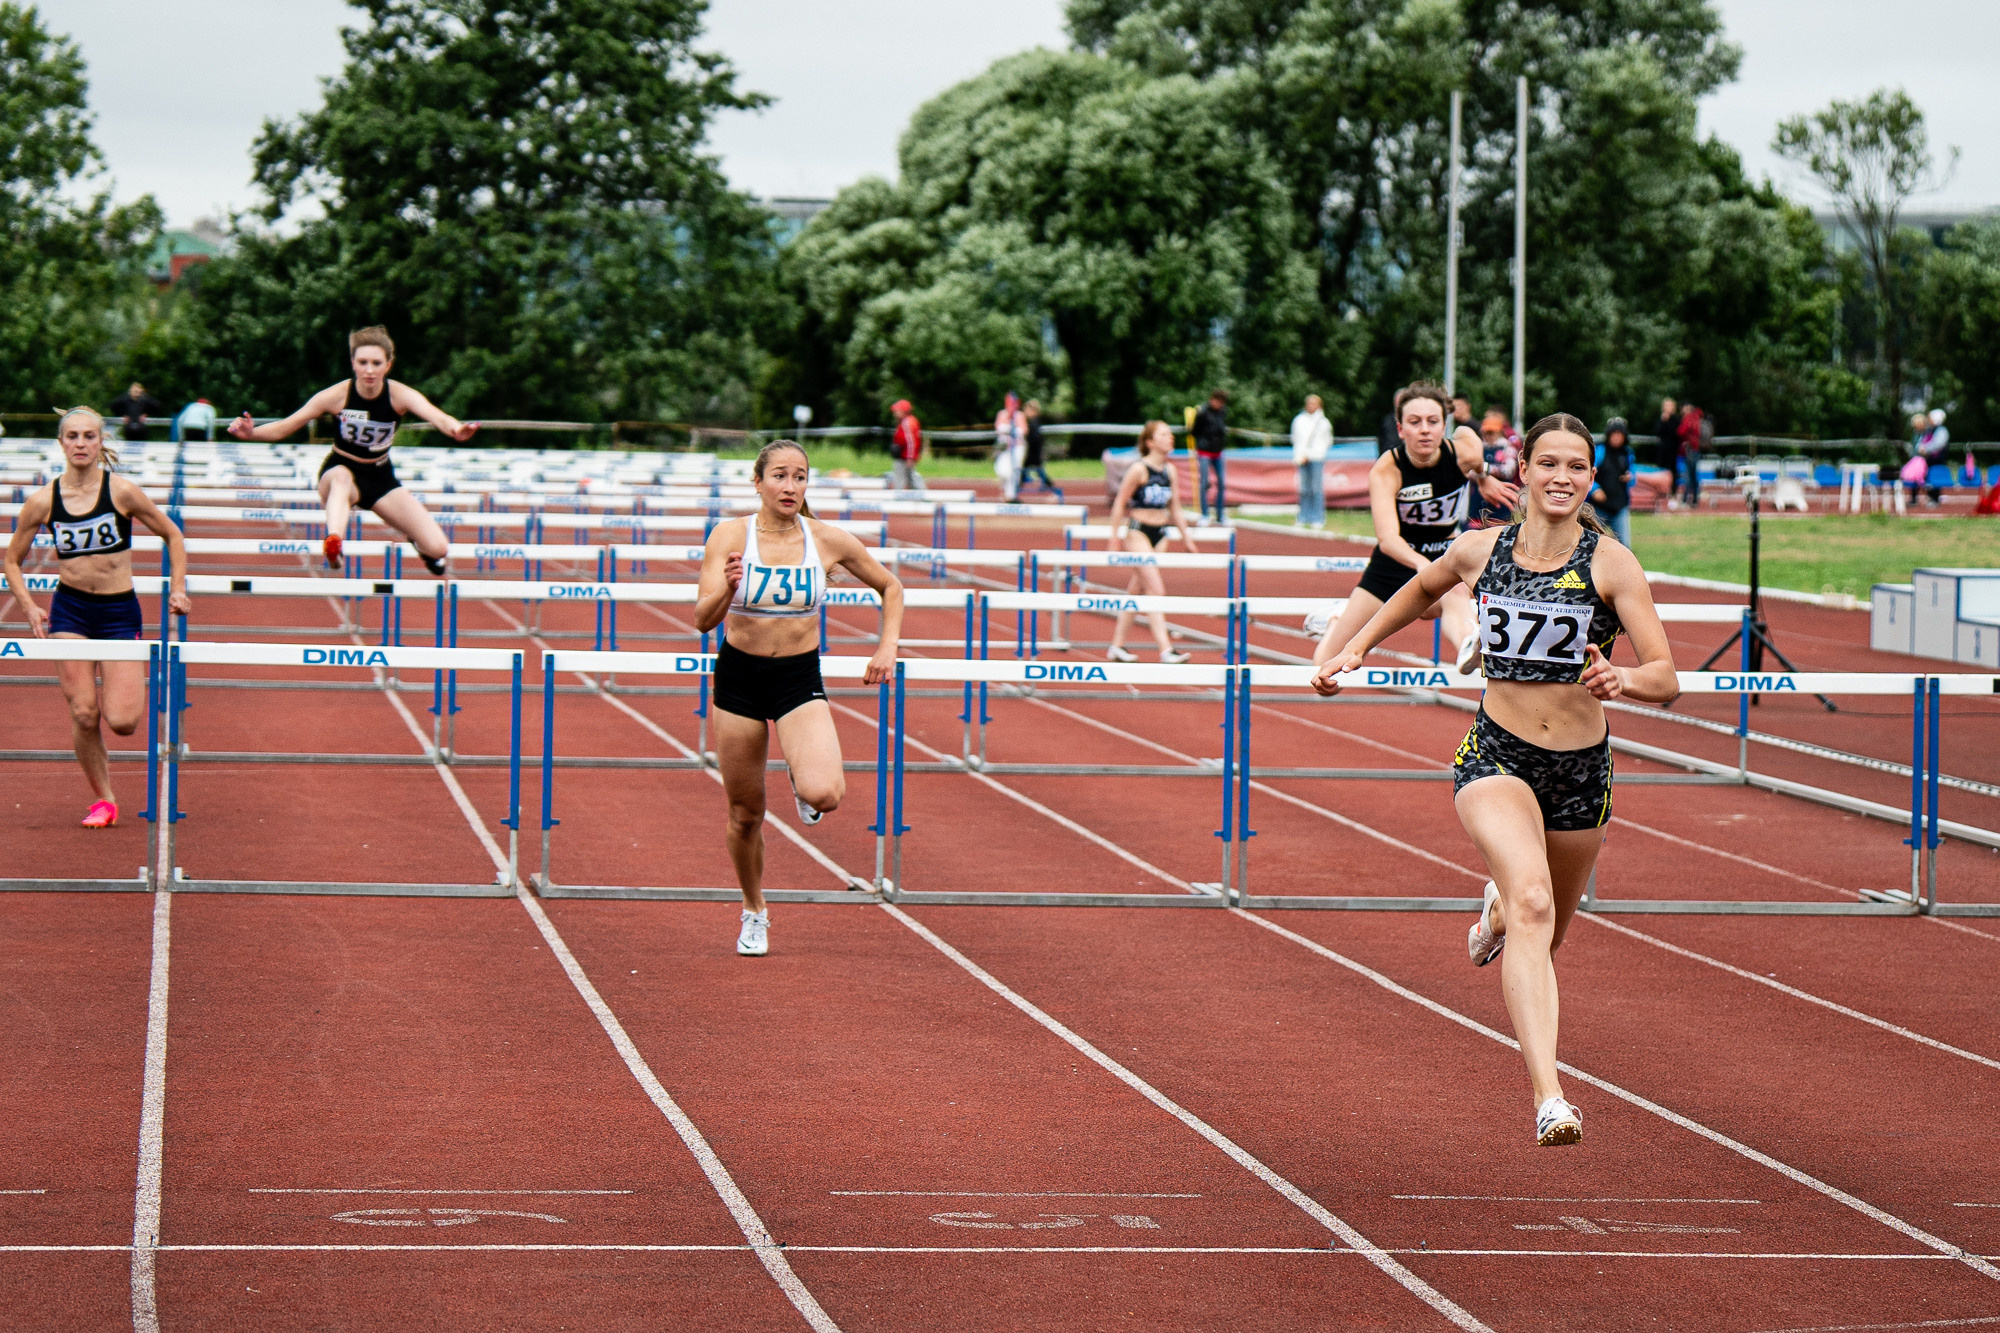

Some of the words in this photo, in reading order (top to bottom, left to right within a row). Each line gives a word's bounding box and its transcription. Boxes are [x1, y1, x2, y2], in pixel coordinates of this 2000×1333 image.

[346, 423, 391, 444] 357
[1397, 488, 1430, 498] NIKE
[1406, 491, 1460, 522] 437
[61, 522, 117, 551] 378
[259, 542, 310, 554] DIMA
[475, 547, 525, 558] DIMA
[897, 551, 946, 562] DIMA
[1108, 555, 1157, 565] DIMA
[549, 585, 612, 597] DIMA
[751, 567, 812, 606] 734
[1553, 581, 1586, 589] adidas
[1077, 598, 1138, 611] DIMA
[1488, 598, 1526, 609] АКАДЕМИЯ
[1526, 603, 1553, 613] ЛЕГКОЙ
[1487, 606, 1579, 660] 372
[303, 648, 389, 666] DIMA
[676, 657, 716, 672] DI
[1025, 664, 1108, 681] DIMA
[1367, 670, 1450, 686] DIMA
[1715, 675, 1797, 691] DIMA
